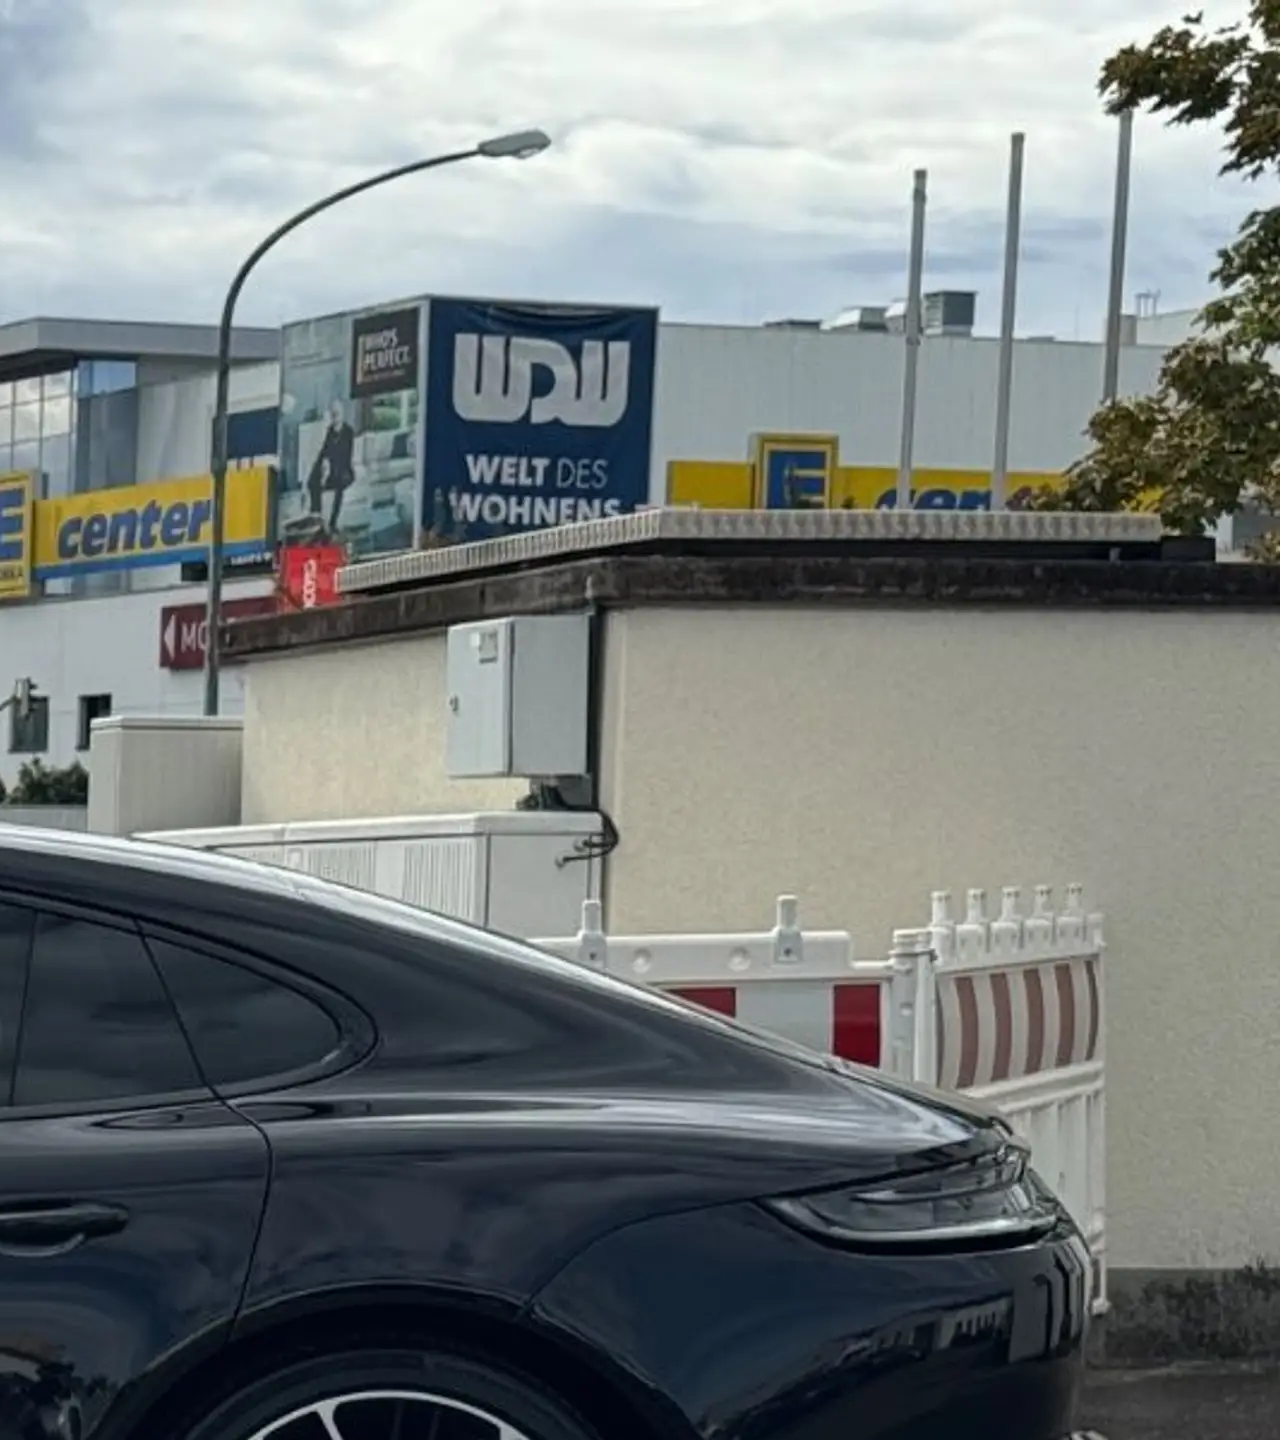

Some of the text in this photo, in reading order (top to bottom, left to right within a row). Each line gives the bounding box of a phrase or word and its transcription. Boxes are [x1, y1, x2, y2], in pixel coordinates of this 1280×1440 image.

[465, 453, 609, 489] WELT DES
[449, 491, 622, 525] WOHNENS
[57, 498, 212, 559] center
